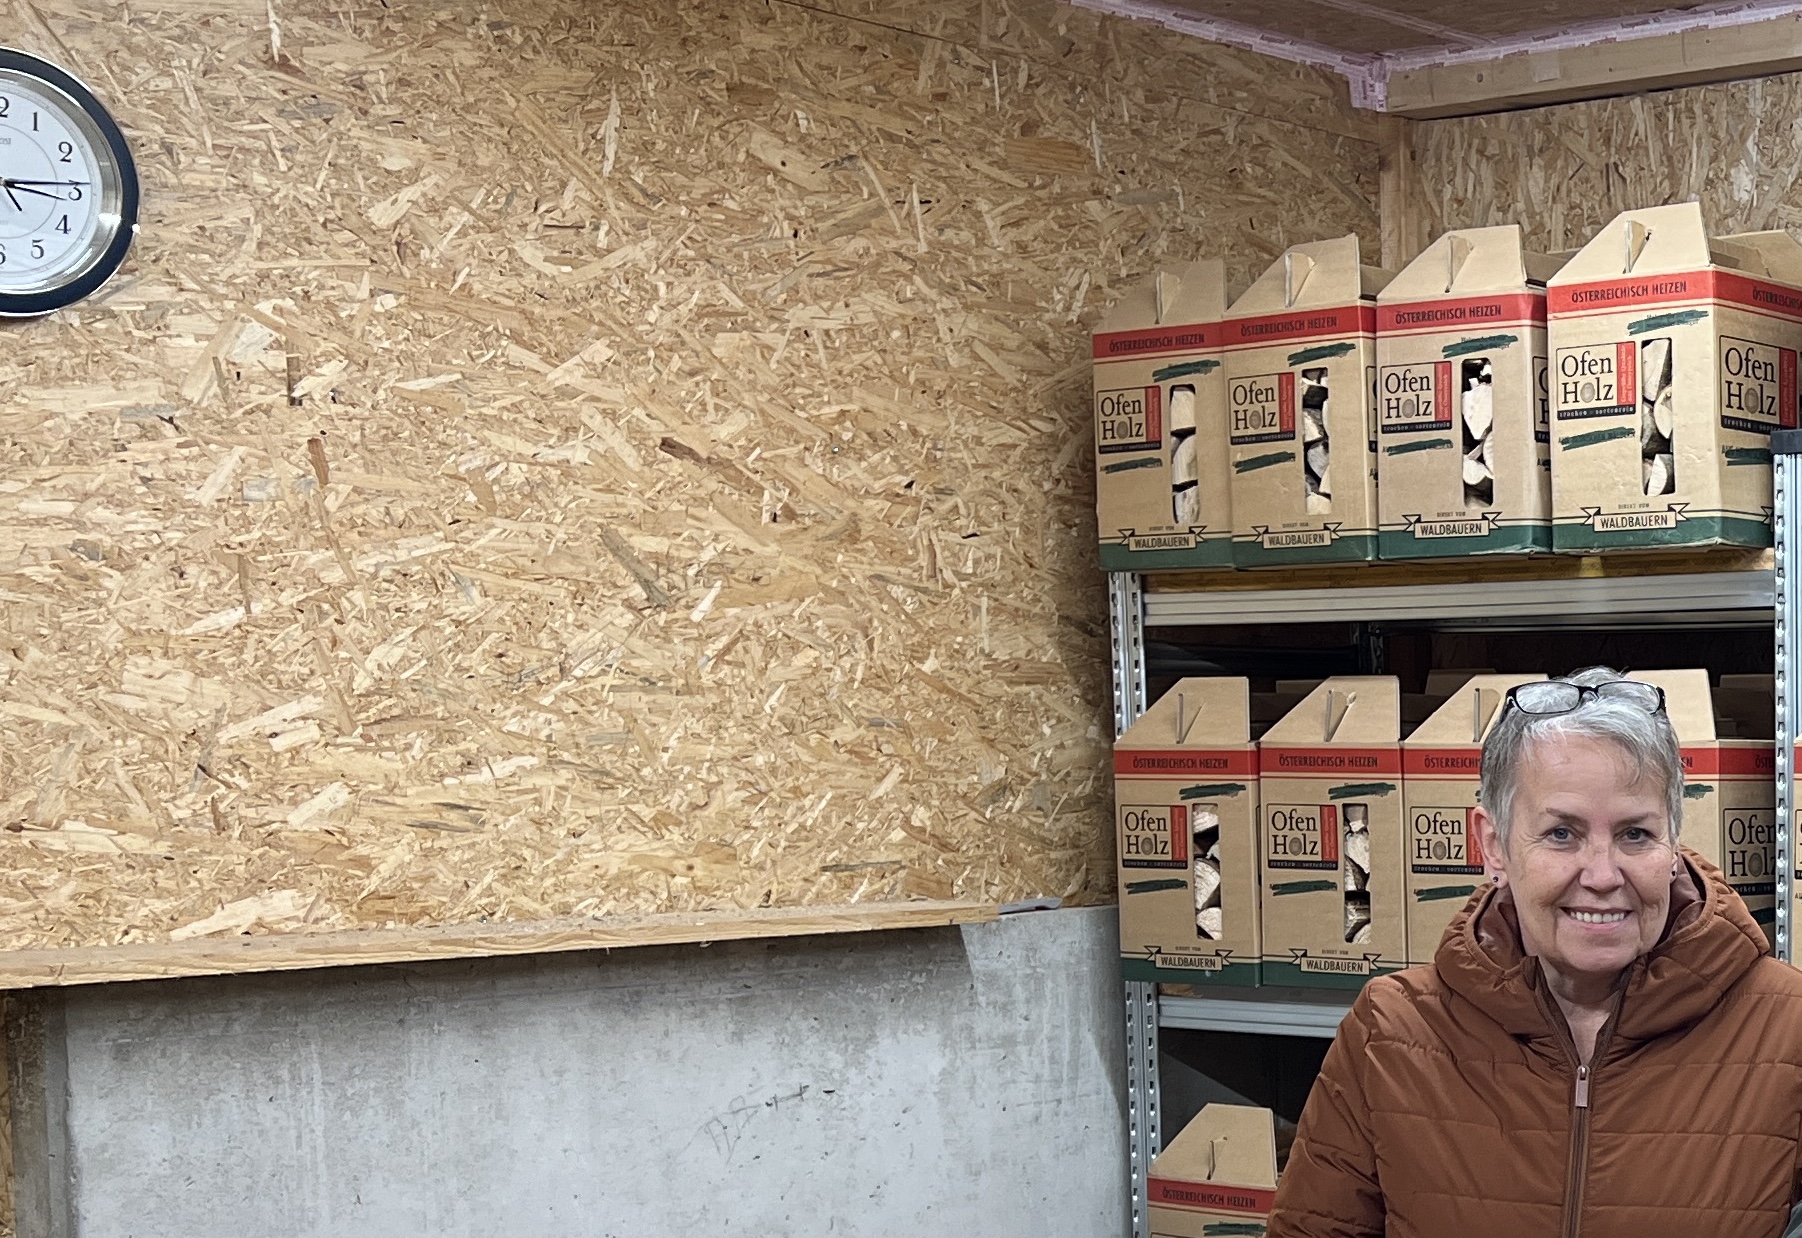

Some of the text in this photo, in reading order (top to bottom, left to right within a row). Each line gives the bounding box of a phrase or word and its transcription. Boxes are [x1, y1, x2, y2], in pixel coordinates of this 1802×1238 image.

[33, 112, 39, 132] 1
[58, 141, 73, 163] 2
[68, 179, 82, 201] 3
[55, 214, 72, 234] 4
[31, 240, 44, 259] 5
[1572, 281, 1686, 303] ÖSTERREICHISCH HEIZEN
[1395, 305, 1501, 324] ÖSTERREICHISCH HEIZEN
[1241, 316, 1337, 336] ÖSTERREICHISCH HEIZEN
[1561, 352, 1613, 377] Ofen
[1725, 348, 1776, 382] Ofen
[1385, 370, 1431, 394] Ofen
[1562, 380, 1614, 404] Holz
[1233, 382, 1274, 405] Ofen
[1725, 382, 1777, 416] Holz
[1101, 395, 1142, 418] Ofen
[1385, 395, 1432, 419] Holz
[1233, 407, 1277, 429] Holz
[1101, 419, 1143, 441] Holz
[1420, 523, 1482, 535] WALDBAUERN
[1601, 514, 1668, 529] WALDBAUERN
[1135, 535, 1190, 548] WALDBAUERN
[1268, 533, 1324, 546] WALDBAUERN
[1133, 757, 1228, 769] ÖSTERREICHISCH HEIZEN
[1279, 754, 1378, 767] ÖSTERREICHISCH HEIZEN
[1125, 809, 1167, 832] Ofen
[1272, 809, 1316, 831] Ofen
[1415, 814, 1462, 836] Ofen
[1126, 835, 1169, 855] Holz
[1272, 835, 1319, 856] Holz
[1415, 837, 1464, 860] Holz
[1161, 957, 1216, 968] WALDBAUERN
[1306, 960, 1363, 972] WALDBAUERN
